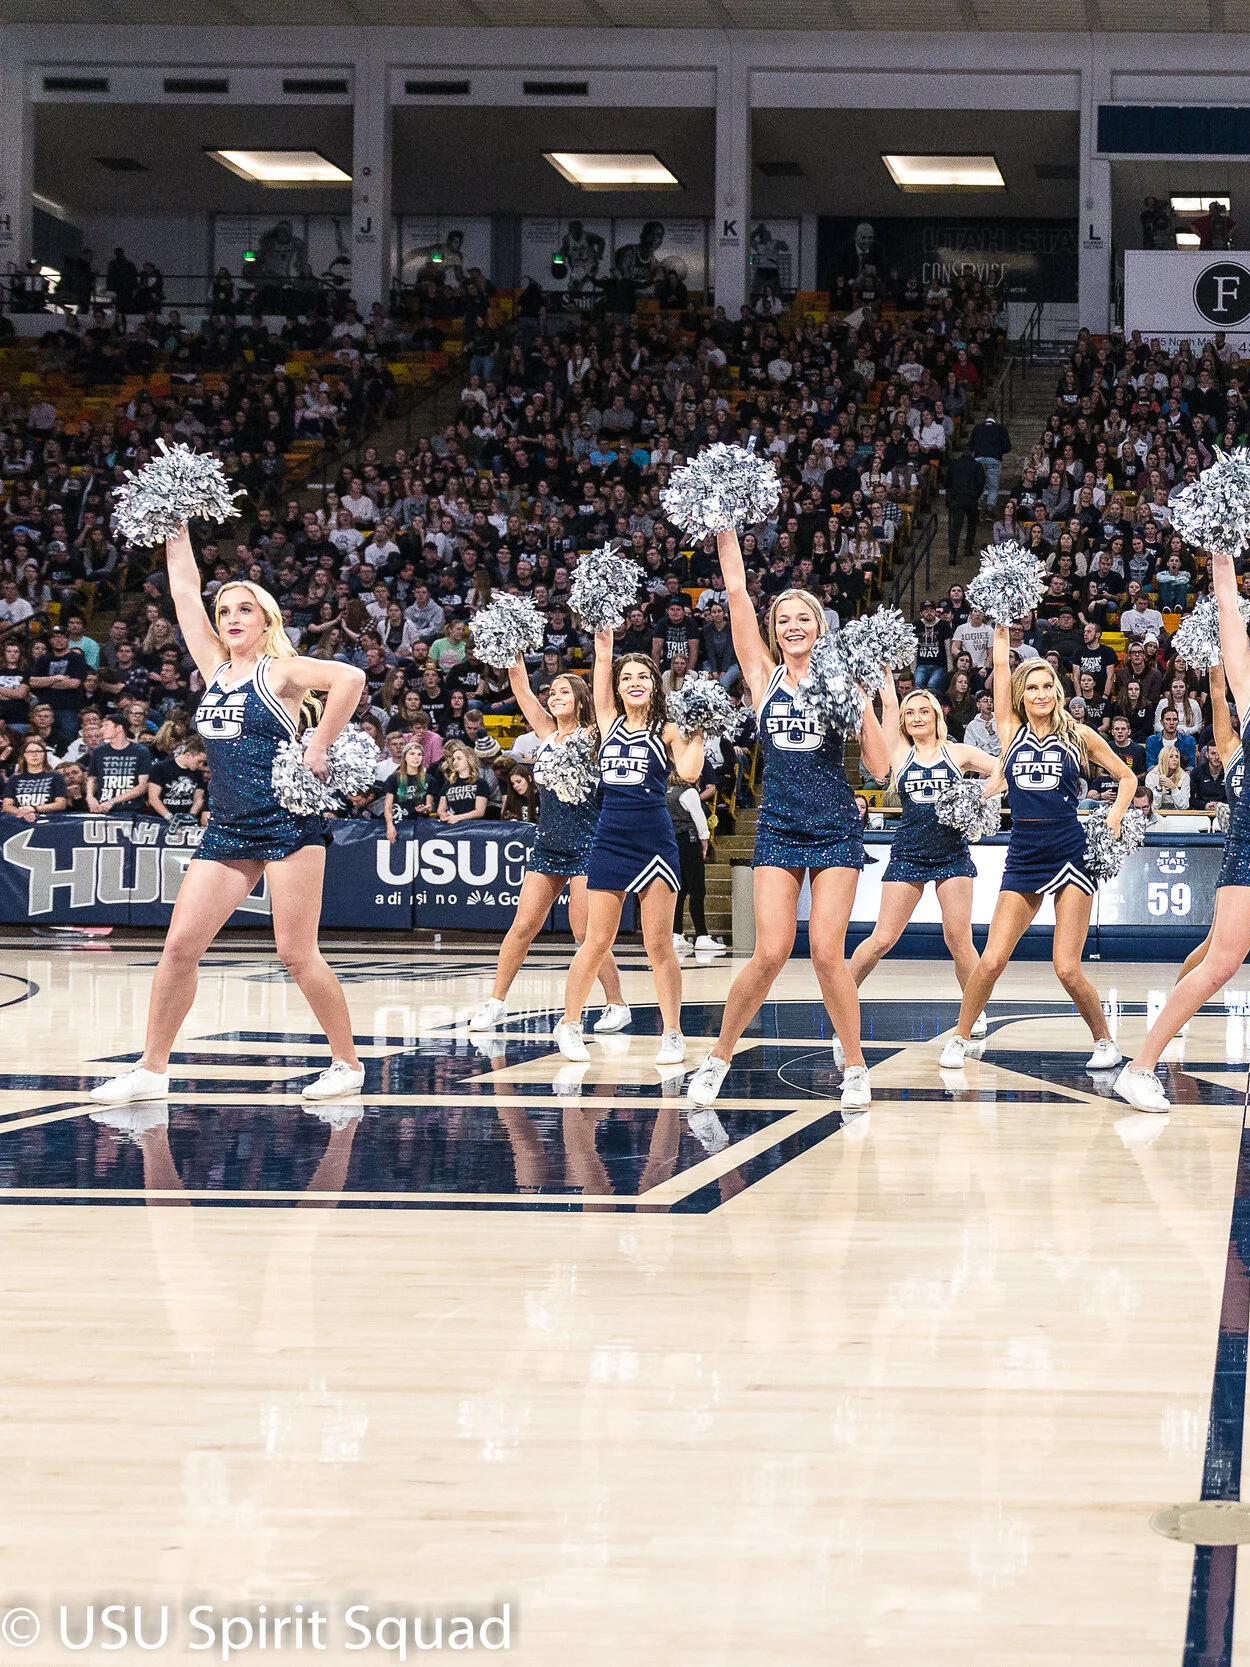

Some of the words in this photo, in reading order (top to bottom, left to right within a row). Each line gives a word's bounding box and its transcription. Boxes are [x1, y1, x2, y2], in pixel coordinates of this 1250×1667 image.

[360, 217, 372, 234] J
[723, 220, 737, 236] K
[1089, 224, 1101, 240] L
[1212, 276, 1241, 312] F
[919, 650, 939, 658] WAY
[195, 706, 245, 723] STATE
[601, 757, 649, 774] STATE
[1012, 761, 1063, 777] STATE
[102, 775, 135, 789] TRUE
[15, 794, 51, 808] TRUE
[83, 820, 160, 845] UTAH
[504, 841, 535, 863] Cr
[376, 839, 499, 886] USU
[498, 891, 519, 906] Go
[1147, 882, 1191, 917] 59
